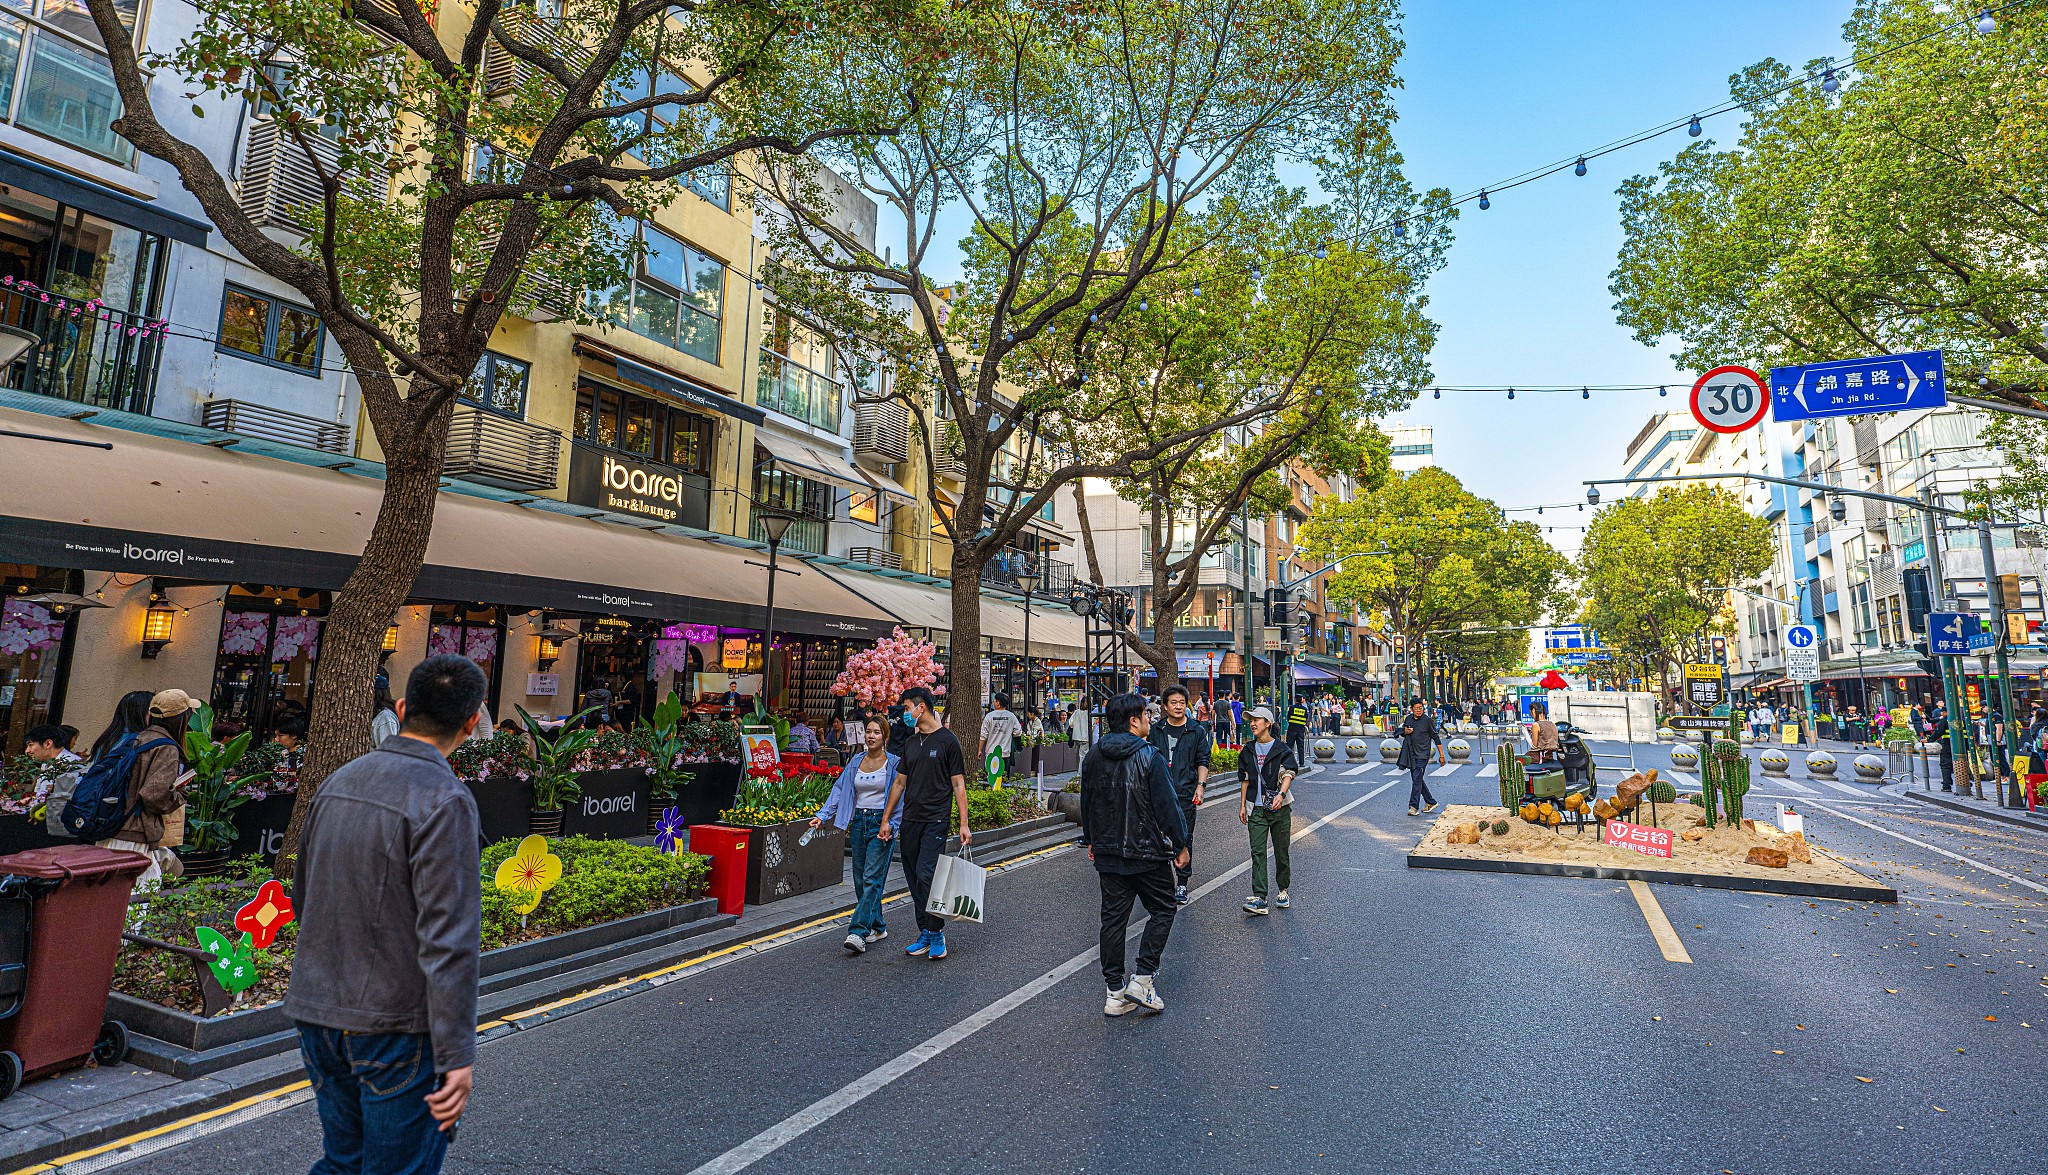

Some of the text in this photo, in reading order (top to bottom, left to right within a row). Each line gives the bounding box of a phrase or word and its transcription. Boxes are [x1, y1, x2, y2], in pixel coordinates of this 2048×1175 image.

[1819, 370, 1890, 391] 锦嘉路
[1924, 370, 1937, 381] 南
[1707, 383, 1753, 416] 30
[1777, 385, 1789, 396] 北
[602, 455, 683, 508] ibarrel
[608, 493, 677, 520] bar&lounge
[124, 543, 184, 565] ibarrel
[602, 593, 630, 607] ibarrel
[1692, 692, 1718, 701] 而生
[583, 790, 636, 816] ibarrel
[1631, 828, 1668, 844] 台铃
